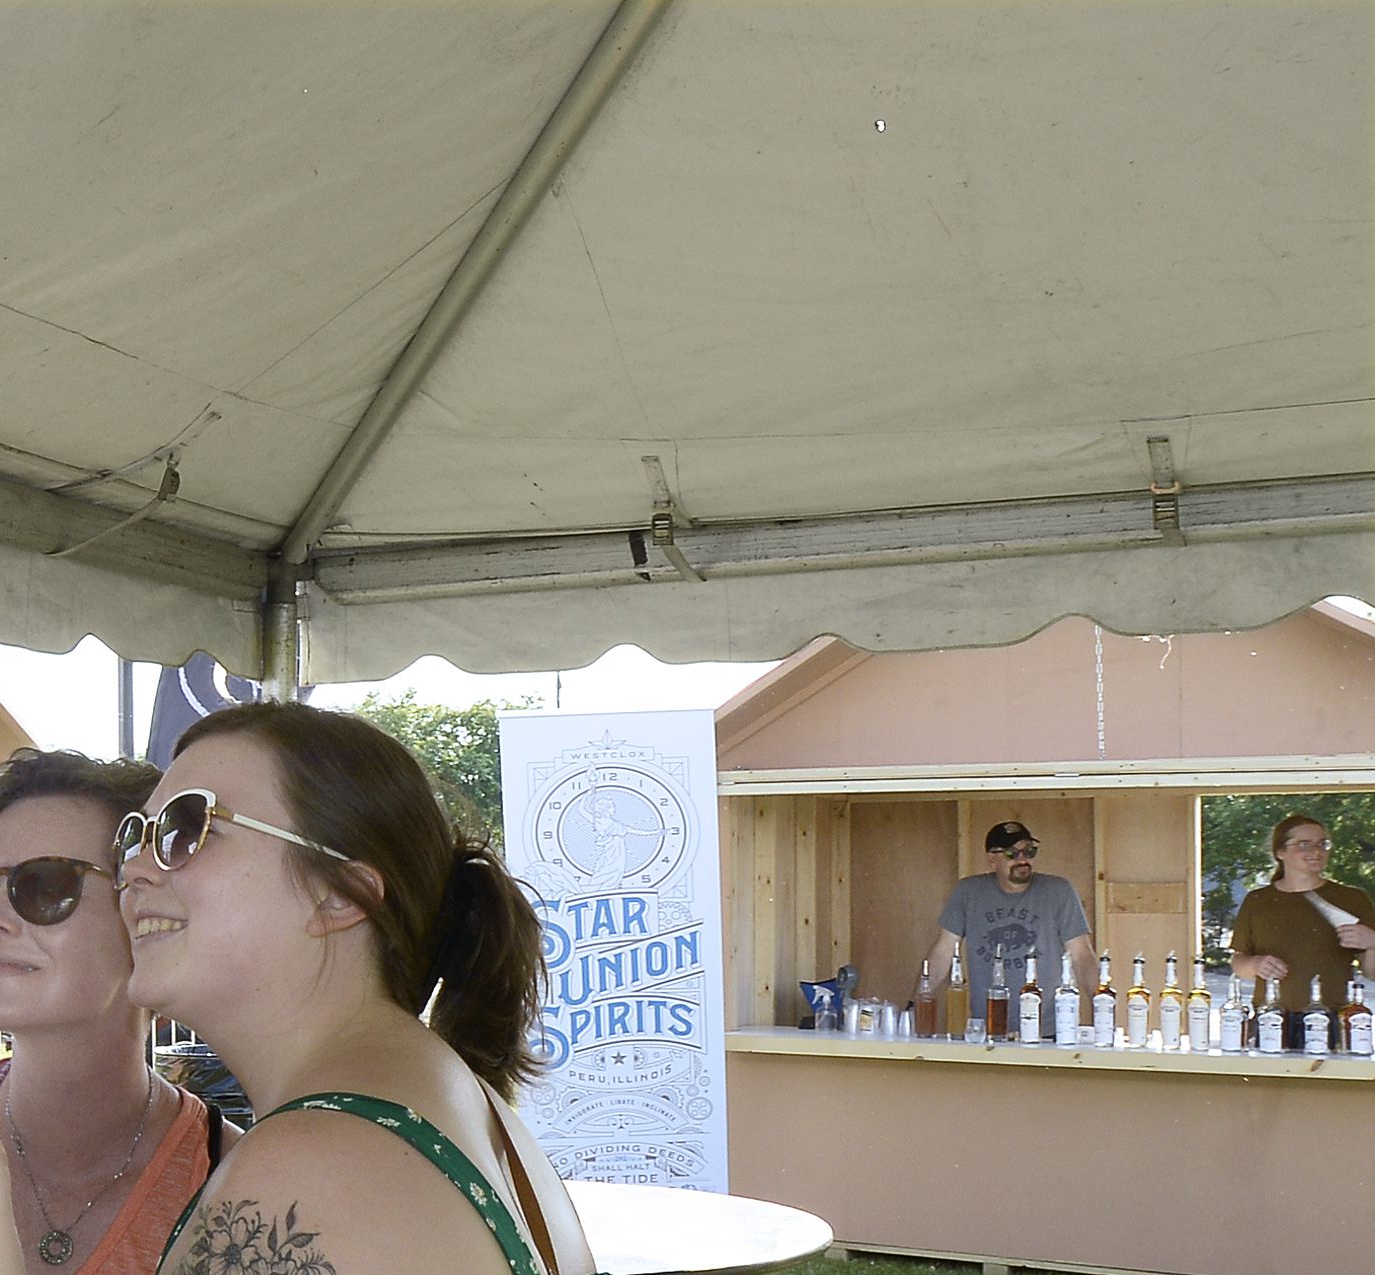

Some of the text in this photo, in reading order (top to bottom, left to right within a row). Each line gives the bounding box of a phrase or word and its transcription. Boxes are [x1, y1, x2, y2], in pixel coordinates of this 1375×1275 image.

[570, 751, 646, 760] WESTCLOX
[602, 772, 617, 781] 12
[572, 781, 581, 790] 11
[549, 801, 562, 810] 10
[659, 797, 669, 807] 2
[543, 830, 553, 840] 9
[671, 826, 680, 836] 3
[661, 855, 671, 864] 4
[641, 874, 651, 884] 5
[985, 907, 1039, 925] BEAST
[531, 896, 649, 969] STAR
[557, 930, 700, 1006] UNION
[529, 1000, 695, 1070] SPIRITS
[574, 1144, 641, 1160] DIVIDING
[648, 1146, 695, 1167] DEEDS
[592, 1163, 650, 1172] SHALL HALT
[584, 1173, 659, 1185] THE TIDE
